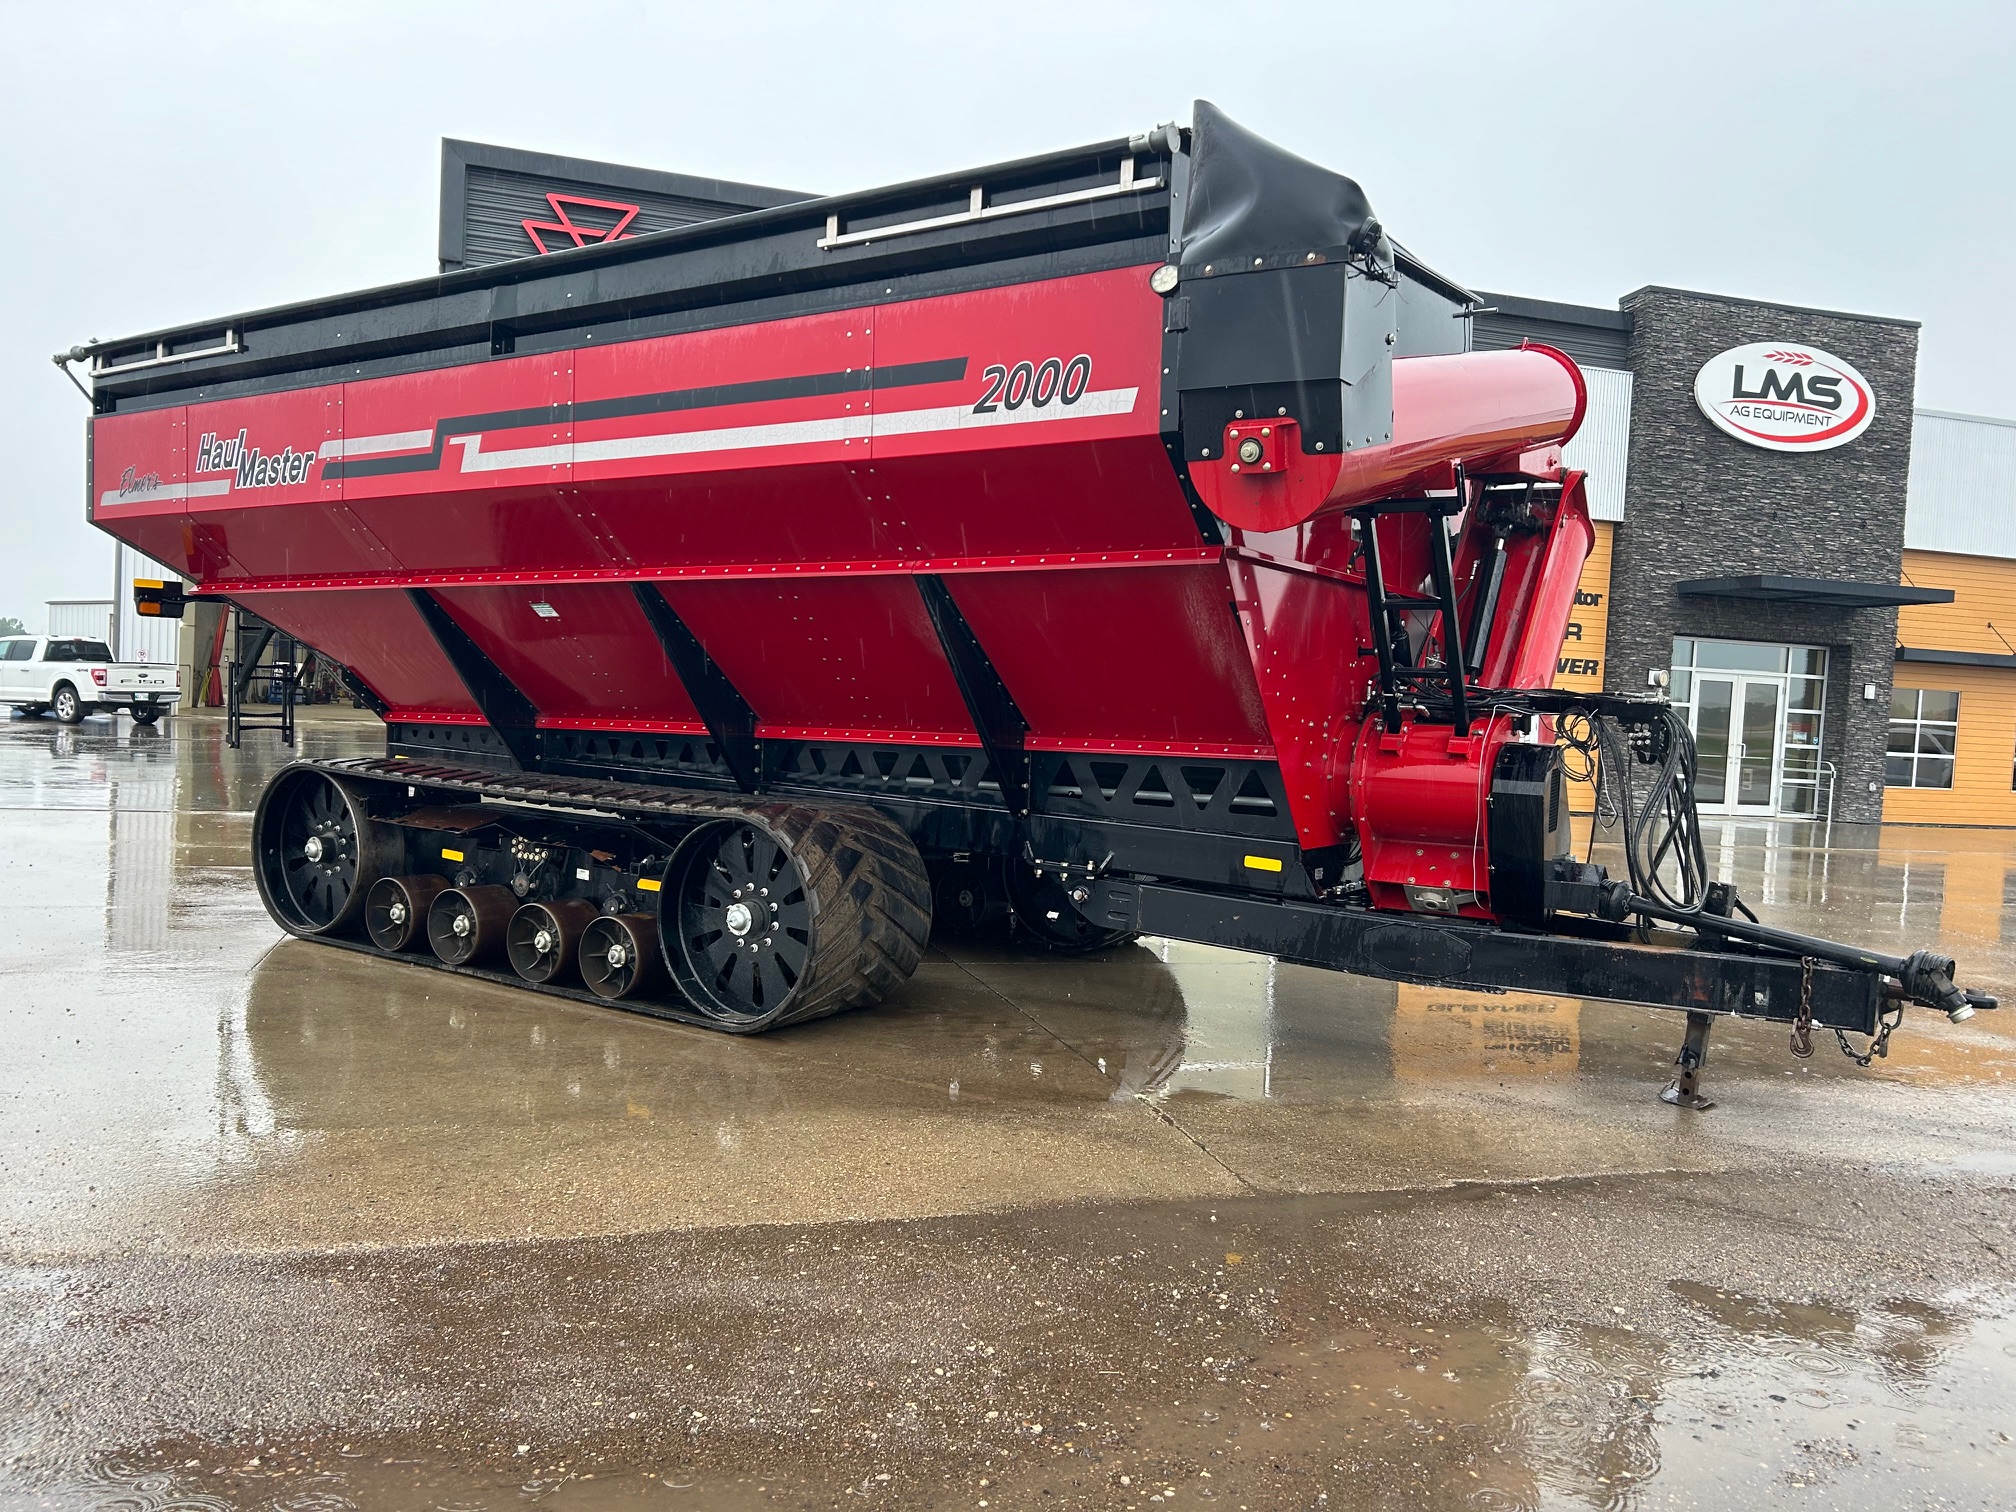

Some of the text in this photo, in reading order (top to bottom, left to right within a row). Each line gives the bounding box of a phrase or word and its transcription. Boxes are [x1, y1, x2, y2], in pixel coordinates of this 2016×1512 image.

[972, 354, 1092, 414] 2000
[1733, 364, 1842, 411] LMS
[1730, 404, 1832, 427] AG EQUIPMENT
[195, 428, 247, 473] Haul
[235, 446, 316, 490] Master
[1573, 589, 1602, 606] tor
[1564, 623, 1582, 640] R
